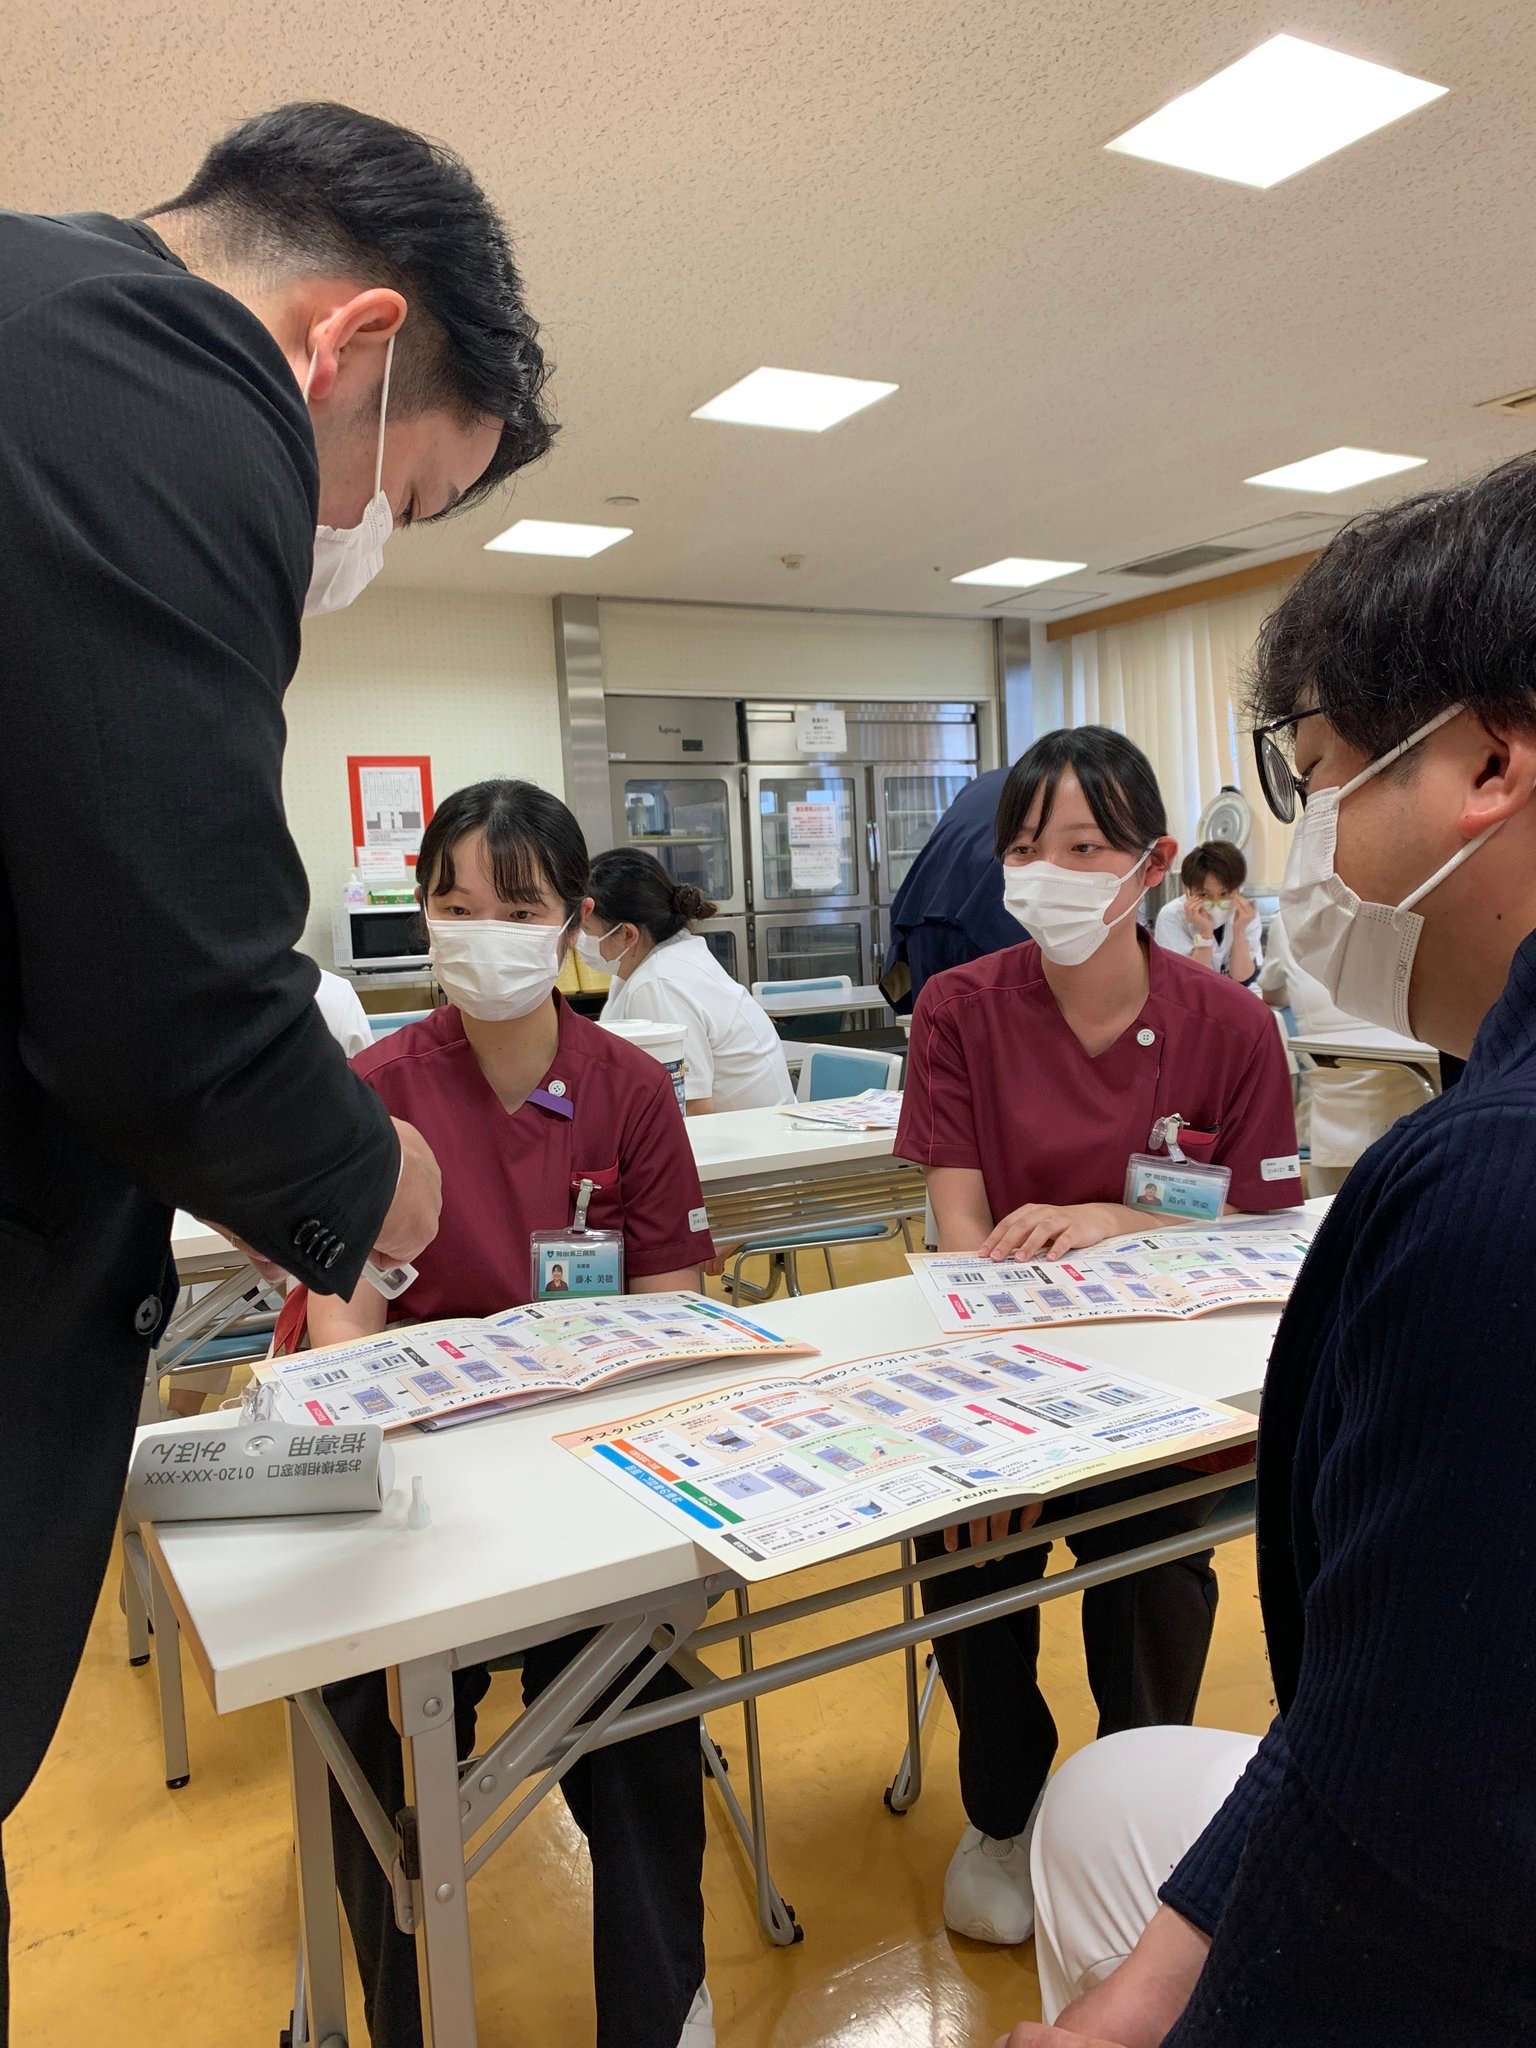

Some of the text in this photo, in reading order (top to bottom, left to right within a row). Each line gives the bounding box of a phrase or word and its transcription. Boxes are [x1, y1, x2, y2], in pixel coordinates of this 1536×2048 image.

[151, 1431, 367, 1464] 指導用 みほん
[143, 1458, 362, 1486] お客様相談窓口 0120-XXX-XXX
[952, 1487, 999, 1502] TEIJIN
